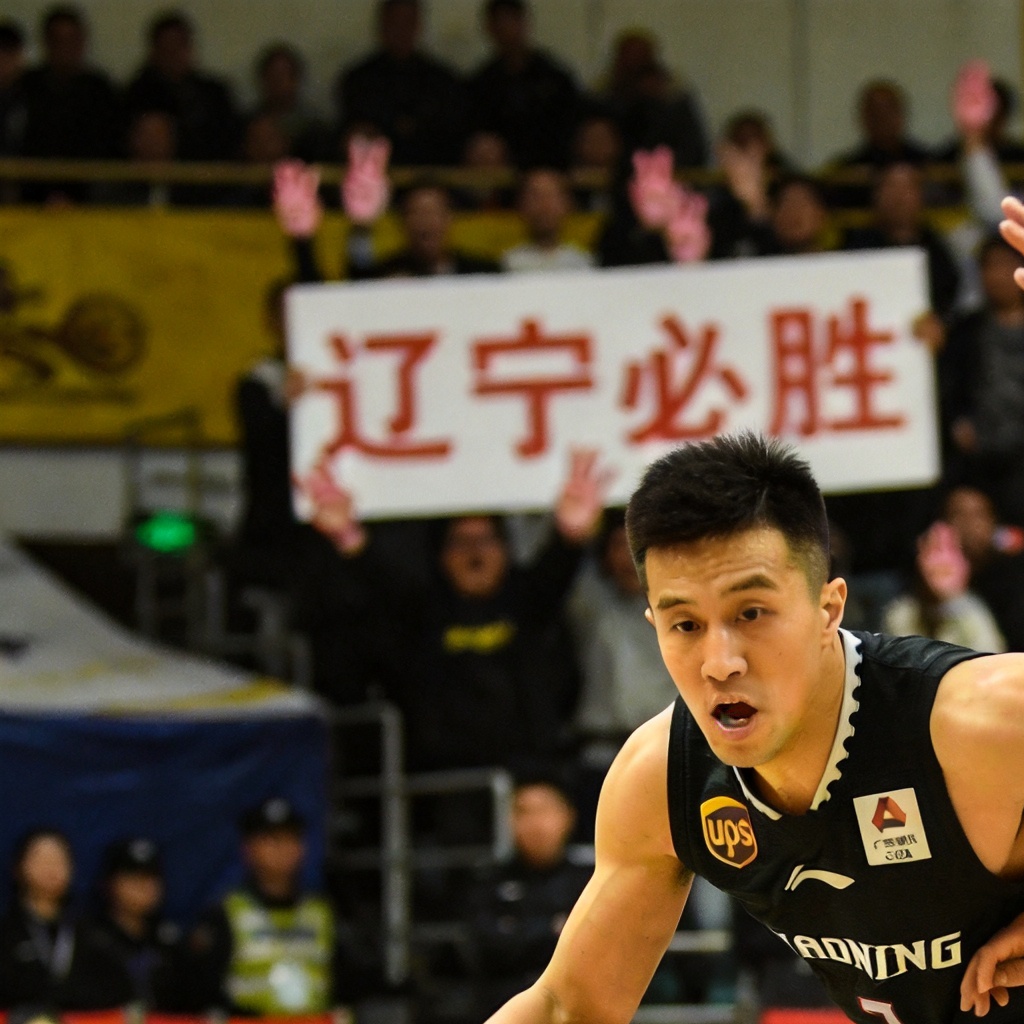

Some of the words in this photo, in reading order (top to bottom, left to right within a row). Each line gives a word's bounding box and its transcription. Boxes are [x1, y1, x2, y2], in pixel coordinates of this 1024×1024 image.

[313, 295, 908, 459] 辽宁必胜
[707, 817, 754, 858] ups
